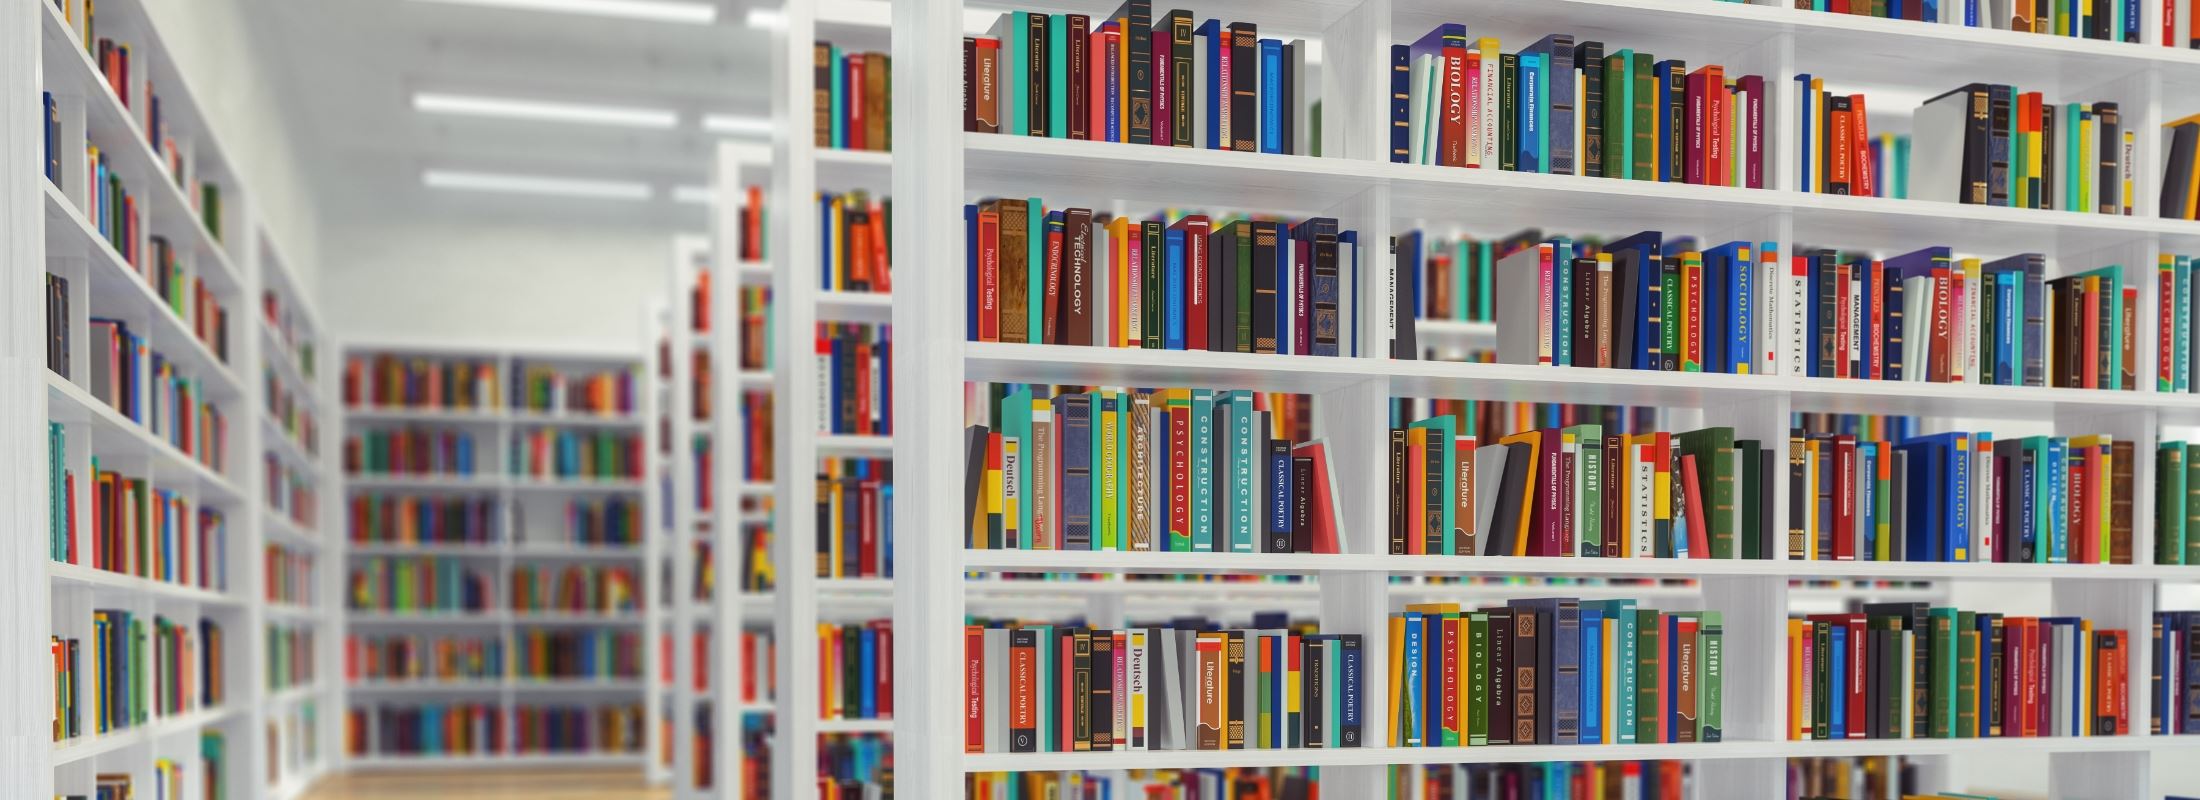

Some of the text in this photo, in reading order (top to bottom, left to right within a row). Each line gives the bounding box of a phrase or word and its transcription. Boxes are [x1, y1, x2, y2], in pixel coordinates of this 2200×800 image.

[983, 58, 992, 101] Literature
[1450, 56, 1462, 126] BIOLOGY
[1711, 99, 1720, 160] Psychological Testing
[1839, 115, 1847, 151] CLASSICAL
[1839, 152, 1847, 179] POETRY
[1860, 149, 1870, 190] BIOCHEMISTRY
[2124, 143, 2133, 179] Deutsch
[1080, 223, 1089, 263] Electrical
[984, 248, 995, 310] Psychological Testing
[1048, 241, 1061, 297] ENDOCRINOLOGY
[1074, 234, 1082, 315] TECHNOLOGY
[1584, 304, 1592, 340] Algebra
[1739, 265, 1748, 344] SOCIOLOGY
[1794, 279, 1802, 373] STATISTICS
[1853, 294, 1861, 352] MANAGEMENT
[1938, 276, 1949, 340] BIOLOGY
[2163, 281, 2171, 372] PSYCHOLOGY
[2123, 307, 2133, 351] Literature
[1037, 427, 1045, 442] The
[1006, 455, 1016, 497] Deutsch
[1036, 443, 1045, 494] Programming
[1137, 426, 1145, 521] ARCHITECTURE
[1176, 420, 1184, 524] PSYCHOLOGY
[1200, 415, 1208, 534] CONSTRUCTION
[1240, 416, 1248, 534] CONSTRUCTION
[1277, 459, 1285, 499] CLASSICAL
[1460, 461, 1470, 508] Literature
[1563, 470, 1571, 512] Programming
[1588, 454, 1597, 492] HISTORY
[1957, 455, 1966, 529] SOCIOLOGY
[1277, 500, 1285, 528] POETRY
[1299, 468, 1308, 526] Linear Algebra
[2023, 469, 2032, 538] CLASSICAL POETRY
[2072, 473, 2082, 525] BIOLOGY
[1019, 652, 1027, 692] CLASSICAL
[1133, 648, 1143, 692] Deutsch
[1206, 661, 1215, 704] Literature
[1682, 643, 1692, 692] Literature
[1709, 640, 1718, 677] HISTORY
[969, 659, 979, 719] Psychological Testing
[1018, 695, 1027, 724] POETRY
[1495, 666, 1503, 706] Algebra
